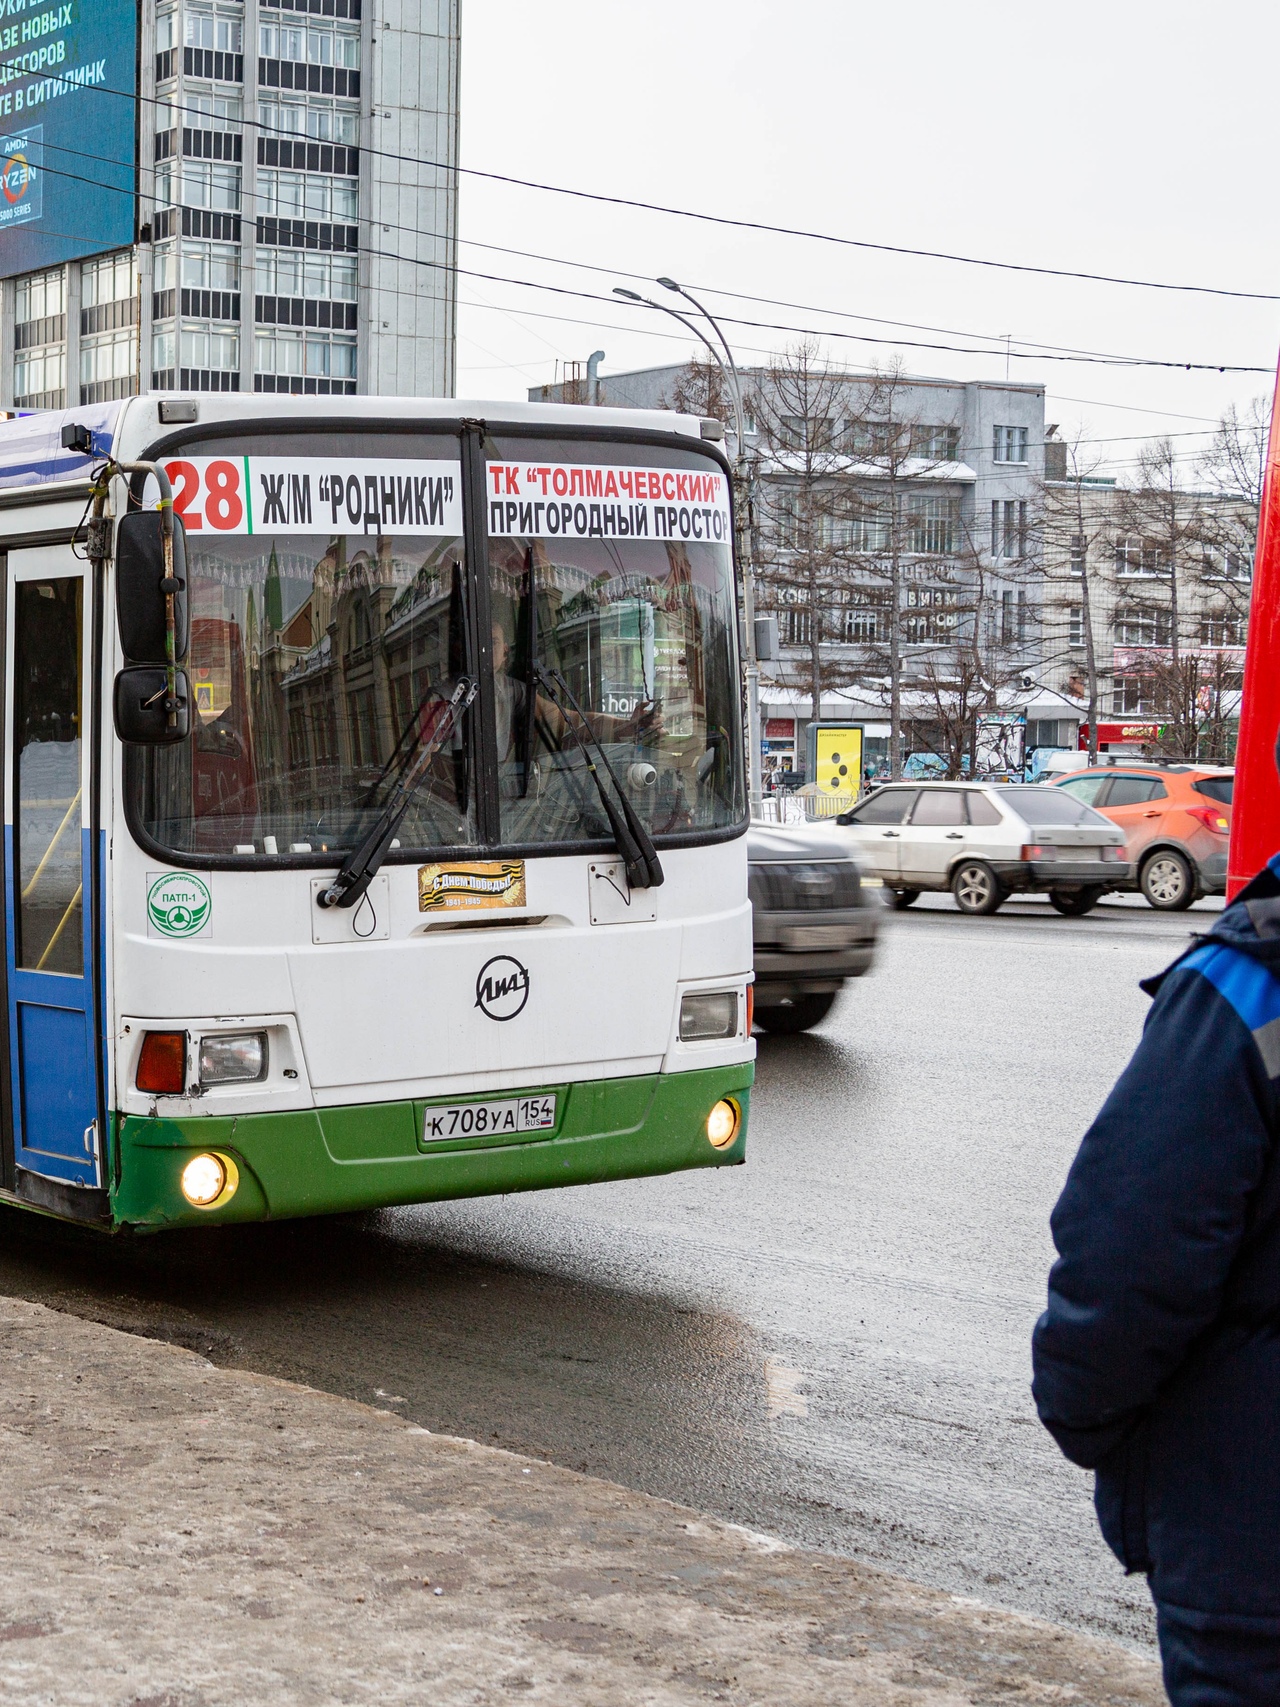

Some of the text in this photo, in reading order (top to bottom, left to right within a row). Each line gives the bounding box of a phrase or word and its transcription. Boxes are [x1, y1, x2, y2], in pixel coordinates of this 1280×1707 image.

[22, 3, 72, 43] НОВЫХ
[15, 89, 24, 112] В
[26, 58, 106, 108] СИТИЛИНК
[4, 137, 26, 153] AMD
[0, 203, 31, 221] 5000 SERIES
[489, 465, 721, 503] ТК “ТОЛМАЧЕВСКИЙ”
[163, 460, 454, 535] 28 Ж/М “РОДНИКИ”
[490, 501, 648, 538] ПРИГОРОДНЫЙ
[609, 694, 638, 712] hair
[433, 874, 511, 892] С Днем Победы!
[162, 893, 196, 902] ПАТП-1
[520, 1099, 550, 1120] 154
[525, 1119, 540, 1127] RUS
